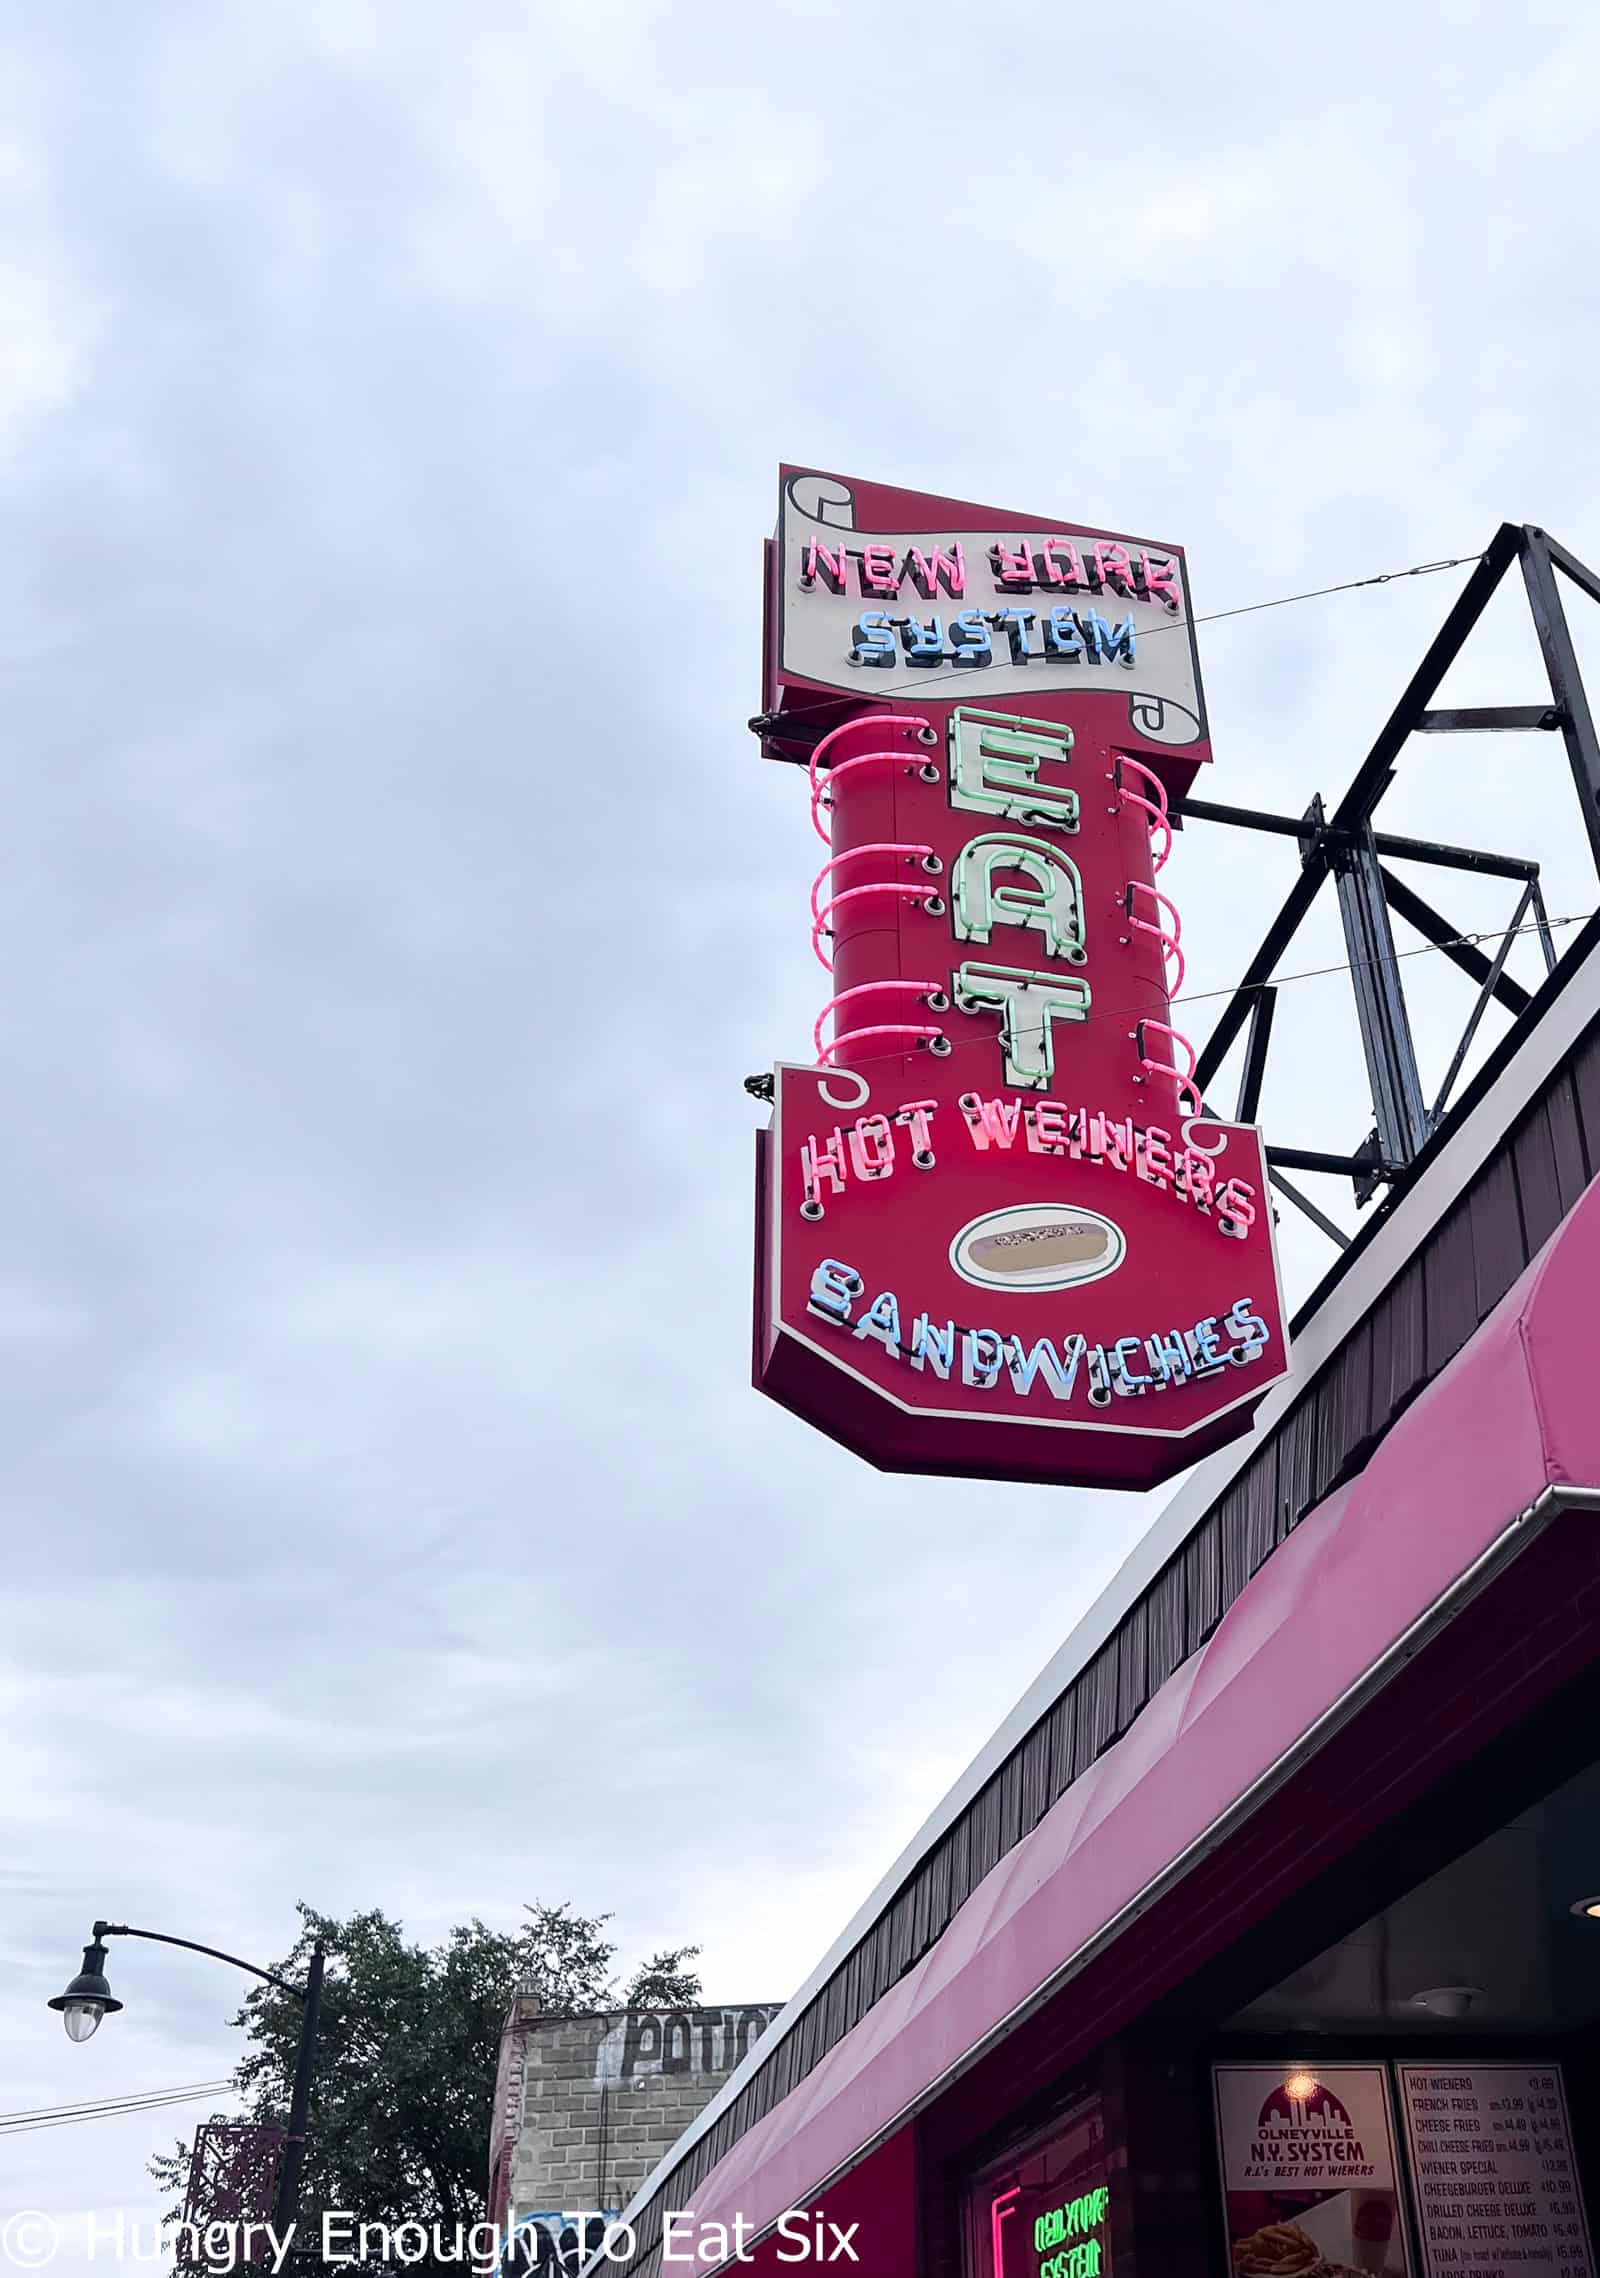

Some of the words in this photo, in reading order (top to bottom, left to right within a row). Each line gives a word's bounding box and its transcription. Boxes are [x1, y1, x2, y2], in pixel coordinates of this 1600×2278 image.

[801, 535, 965, 600] NEW
[988, 537, 1180, 603] YORK
[849, 605, 1136, 668] SYSTEM
[946, 706, 1093, 1091] EAT
[800, 1100, 938, 1206] HOT
[960, 1092, 1256, 1238] WEINERS
[806, 1258, 1268, 1402] SANDWICHES
[1409, 2078, 1428, 2091] HOT
[1430, 2077, 1473, 2091] WIENERS
[1412, 2098, 1449, 2112] FRENCH
[1451, 2098, 1479, 2112] FRIES
[1415, 2119, 1451, 2132] CHEESE
[1453, 2119, 1481, 2132] FRIES
[1258, 2128, 1354, 2140] OLNEYVILLE
[1251, 2143, 1283, 2162] N.Y.
[1288, 2142, 1365, 2161] SYSTEM
[1440, 2140, 1470, 2153] CHEESE
[1471, 2140, 1494, 2153] FRIES
[1274, 2166, 1300, 2177] BEST
[1304, 2166, 1324, 2176] HOT
[1328, 2165, 1376, 2176] WIENERS
[1420, 2161, 1458, 2175] WIENER
[1460, 2160, 1499, 2175] SPECIAL
[1424, 2182, 1496, 2196] CHEESEBURGER
[1498, 2181, 1532, 2195] DELUXE
[1466, 2204, 1502, 2218] CHEESE
[1504, 2202, 1537, 2217] DELUXE
[1511, 2222, 1549, 2239] TOMATO
[1433, 2247, 1458, 2263] TUNA
